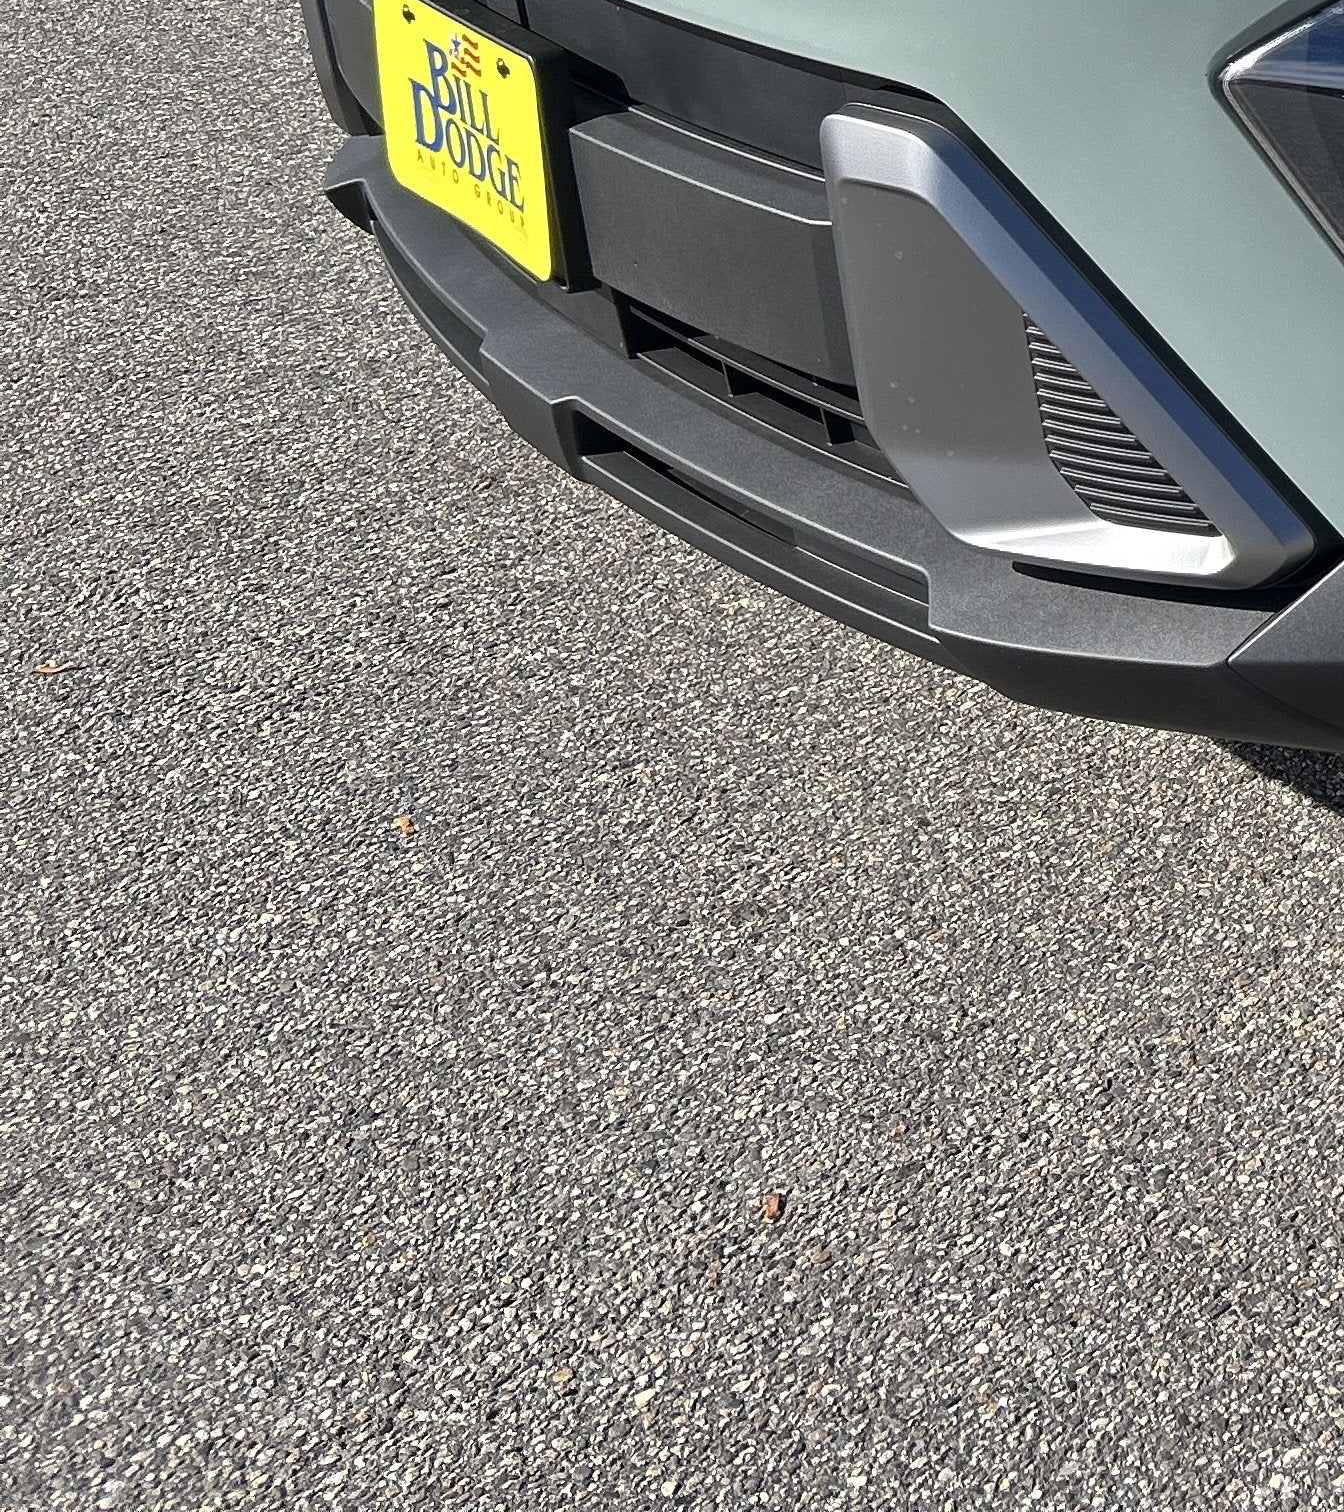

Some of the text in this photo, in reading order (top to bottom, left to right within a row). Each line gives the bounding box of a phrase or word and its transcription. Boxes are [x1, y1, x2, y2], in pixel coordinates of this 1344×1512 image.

[407, 77, 526, 214] DODGE
[422, 38, 501, 146] BILL
[416, 149, 527, 231] AUTO GROUP
